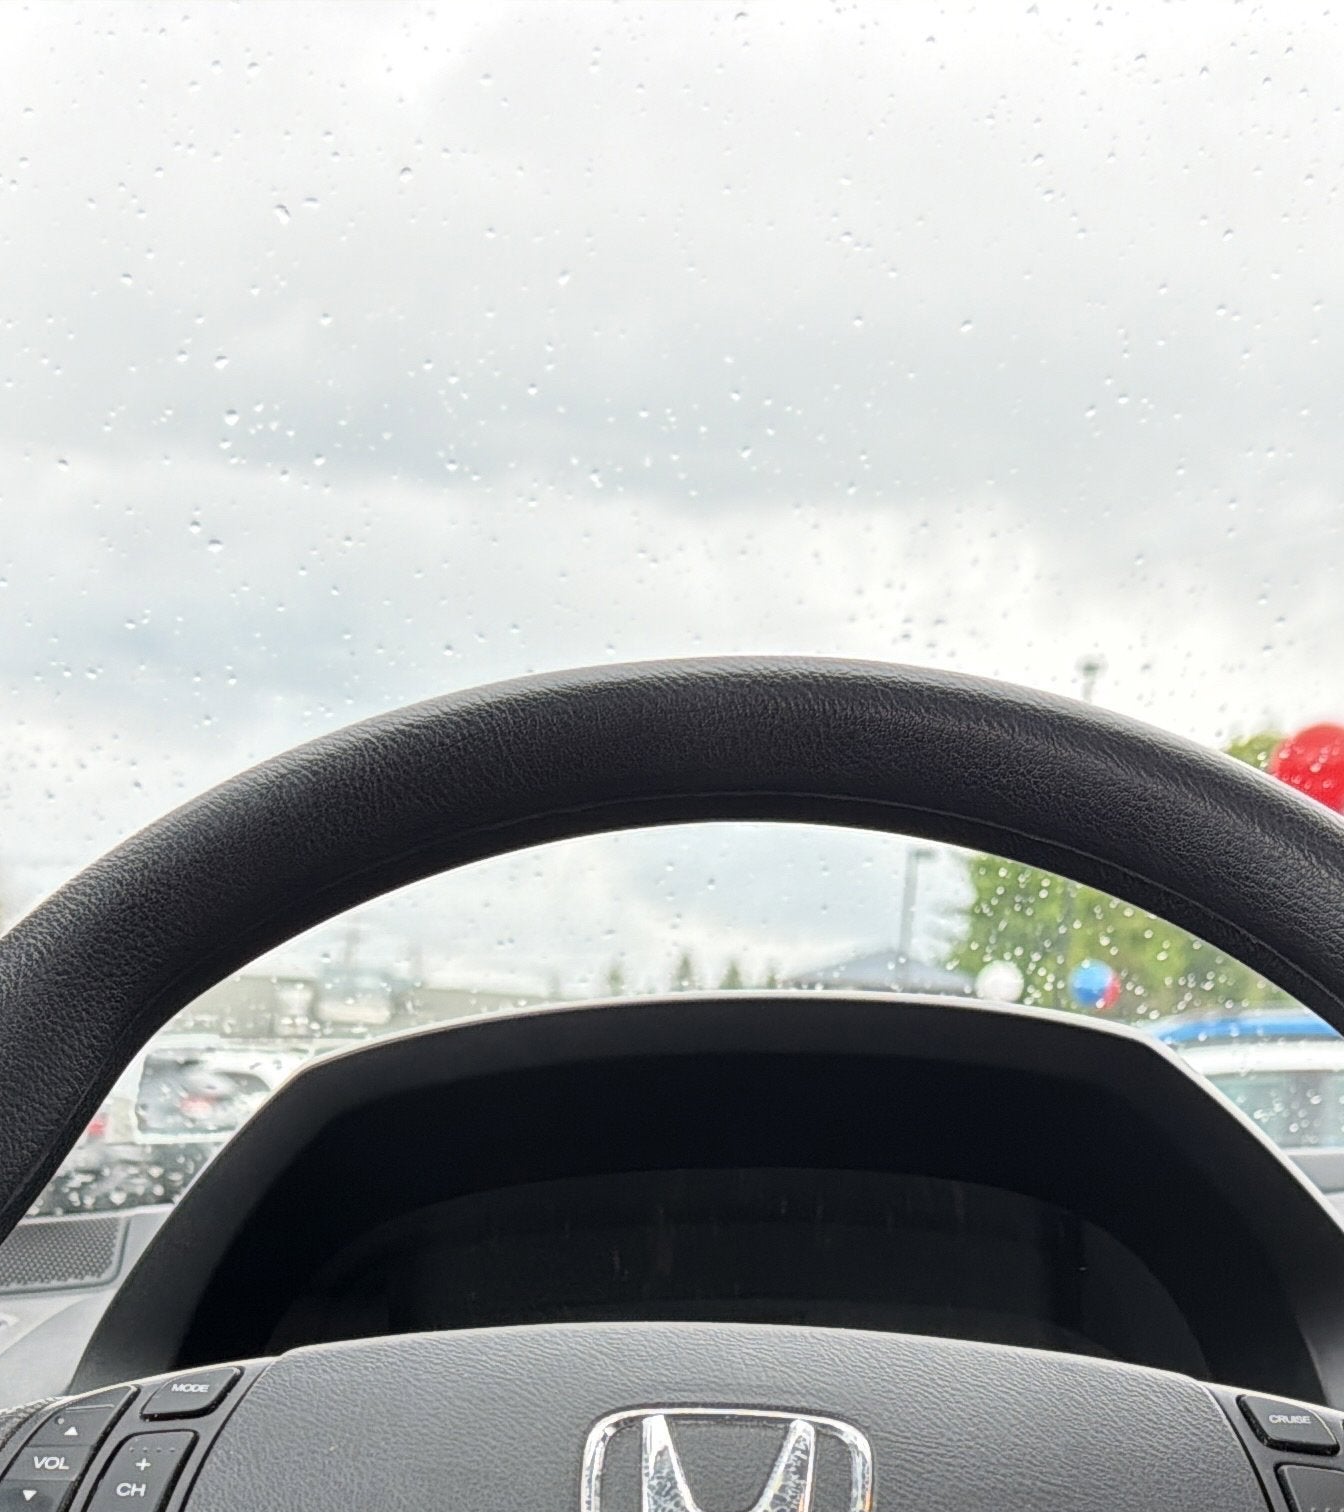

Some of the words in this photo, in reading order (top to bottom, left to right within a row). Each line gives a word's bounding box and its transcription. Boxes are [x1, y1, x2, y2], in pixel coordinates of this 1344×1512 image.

[171, 1382, 210, 1393] MODE
[1269, 1414, 1311, 1425] CRUISE
[33, 1456, 69, 1470] VOL
[116, 1483, 146, 1497] CH
